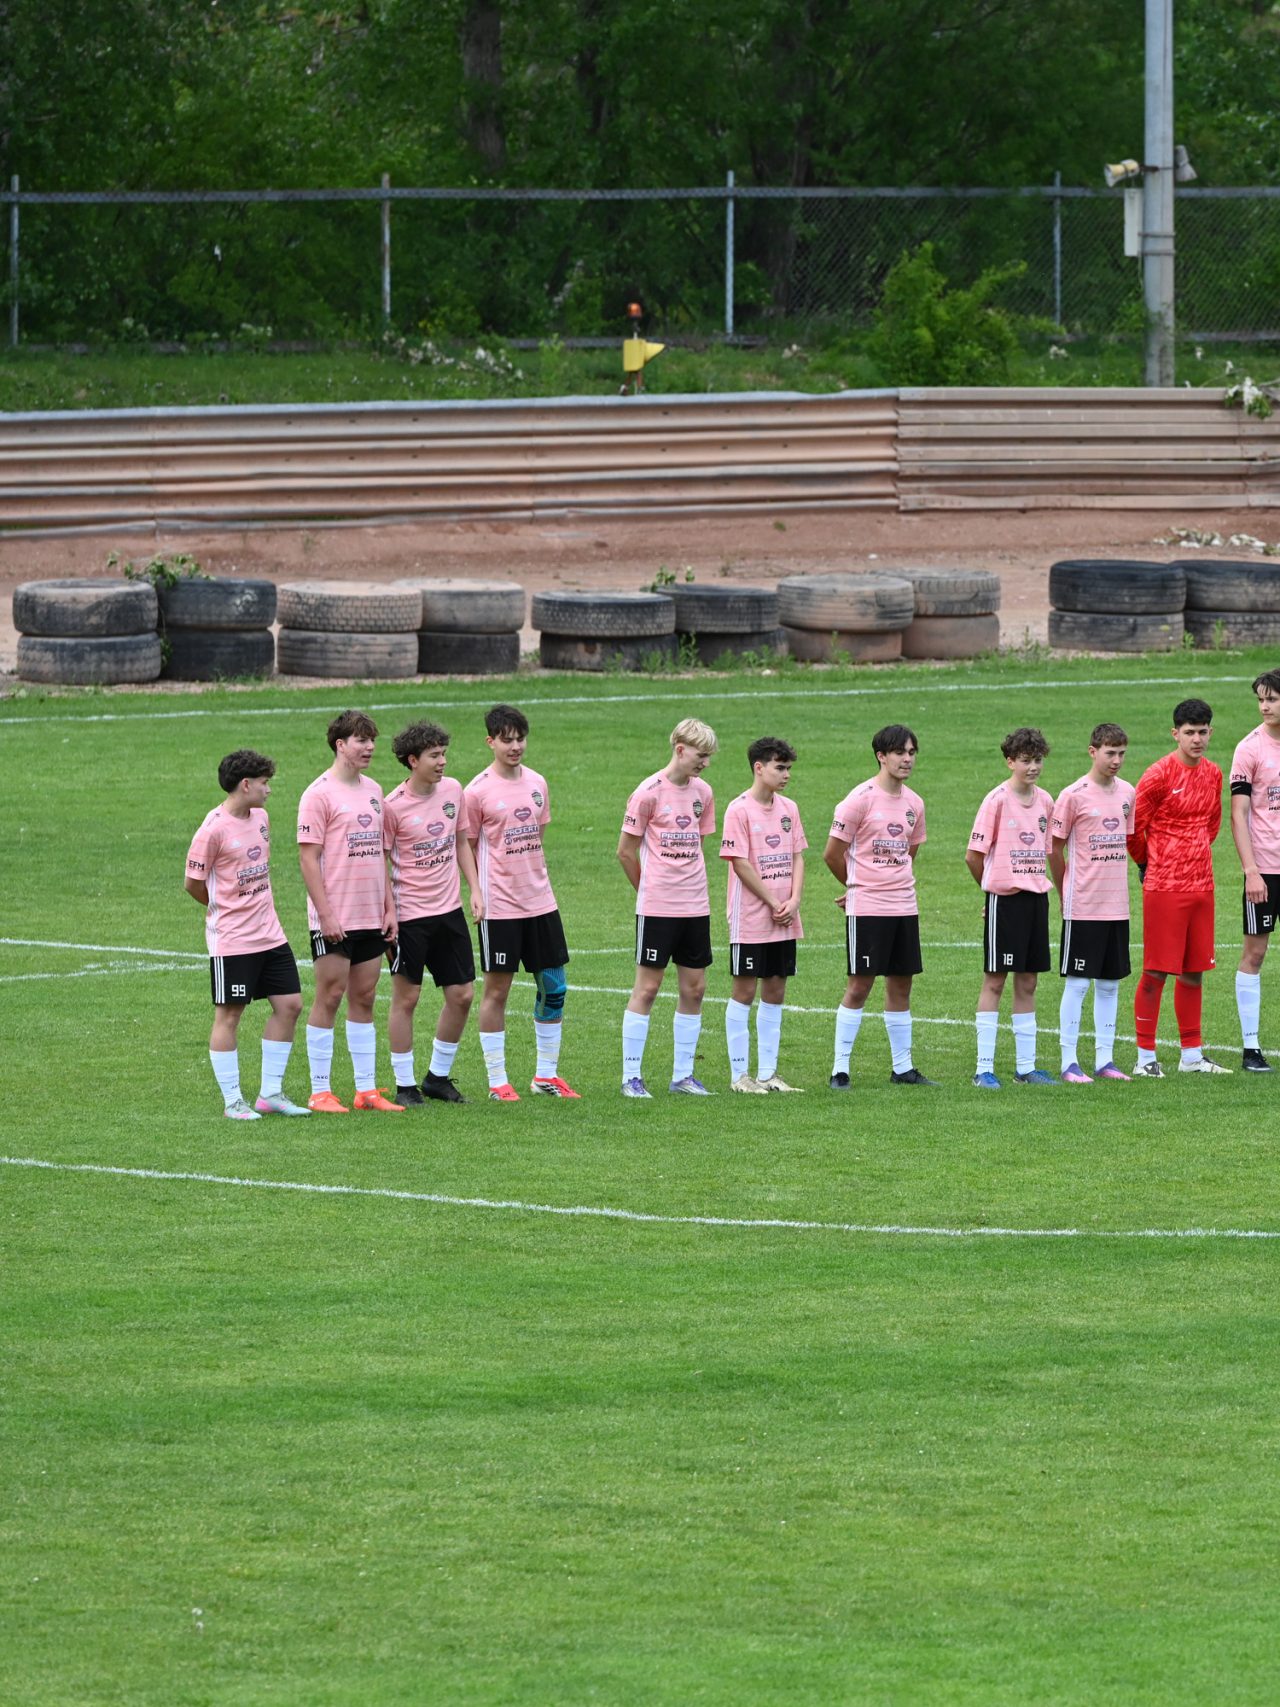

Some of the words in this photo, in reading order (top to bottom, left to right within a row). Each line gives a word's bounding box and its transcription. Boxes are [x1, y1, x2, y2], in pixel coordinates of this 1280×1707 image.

[972, 832, 984, 842] EFM
[189, 860, 205, 871] EFM
[495, 952, 506, 965] 10
[646, 948, 658, 961] 13
[1002, 954, 1014, 966] 18
[746, 958, 754, 969] 5
[862, 956, 870, 968] 7
[1074, 958, 1085, 970] 12
[232, 984, 246, 996] 99
